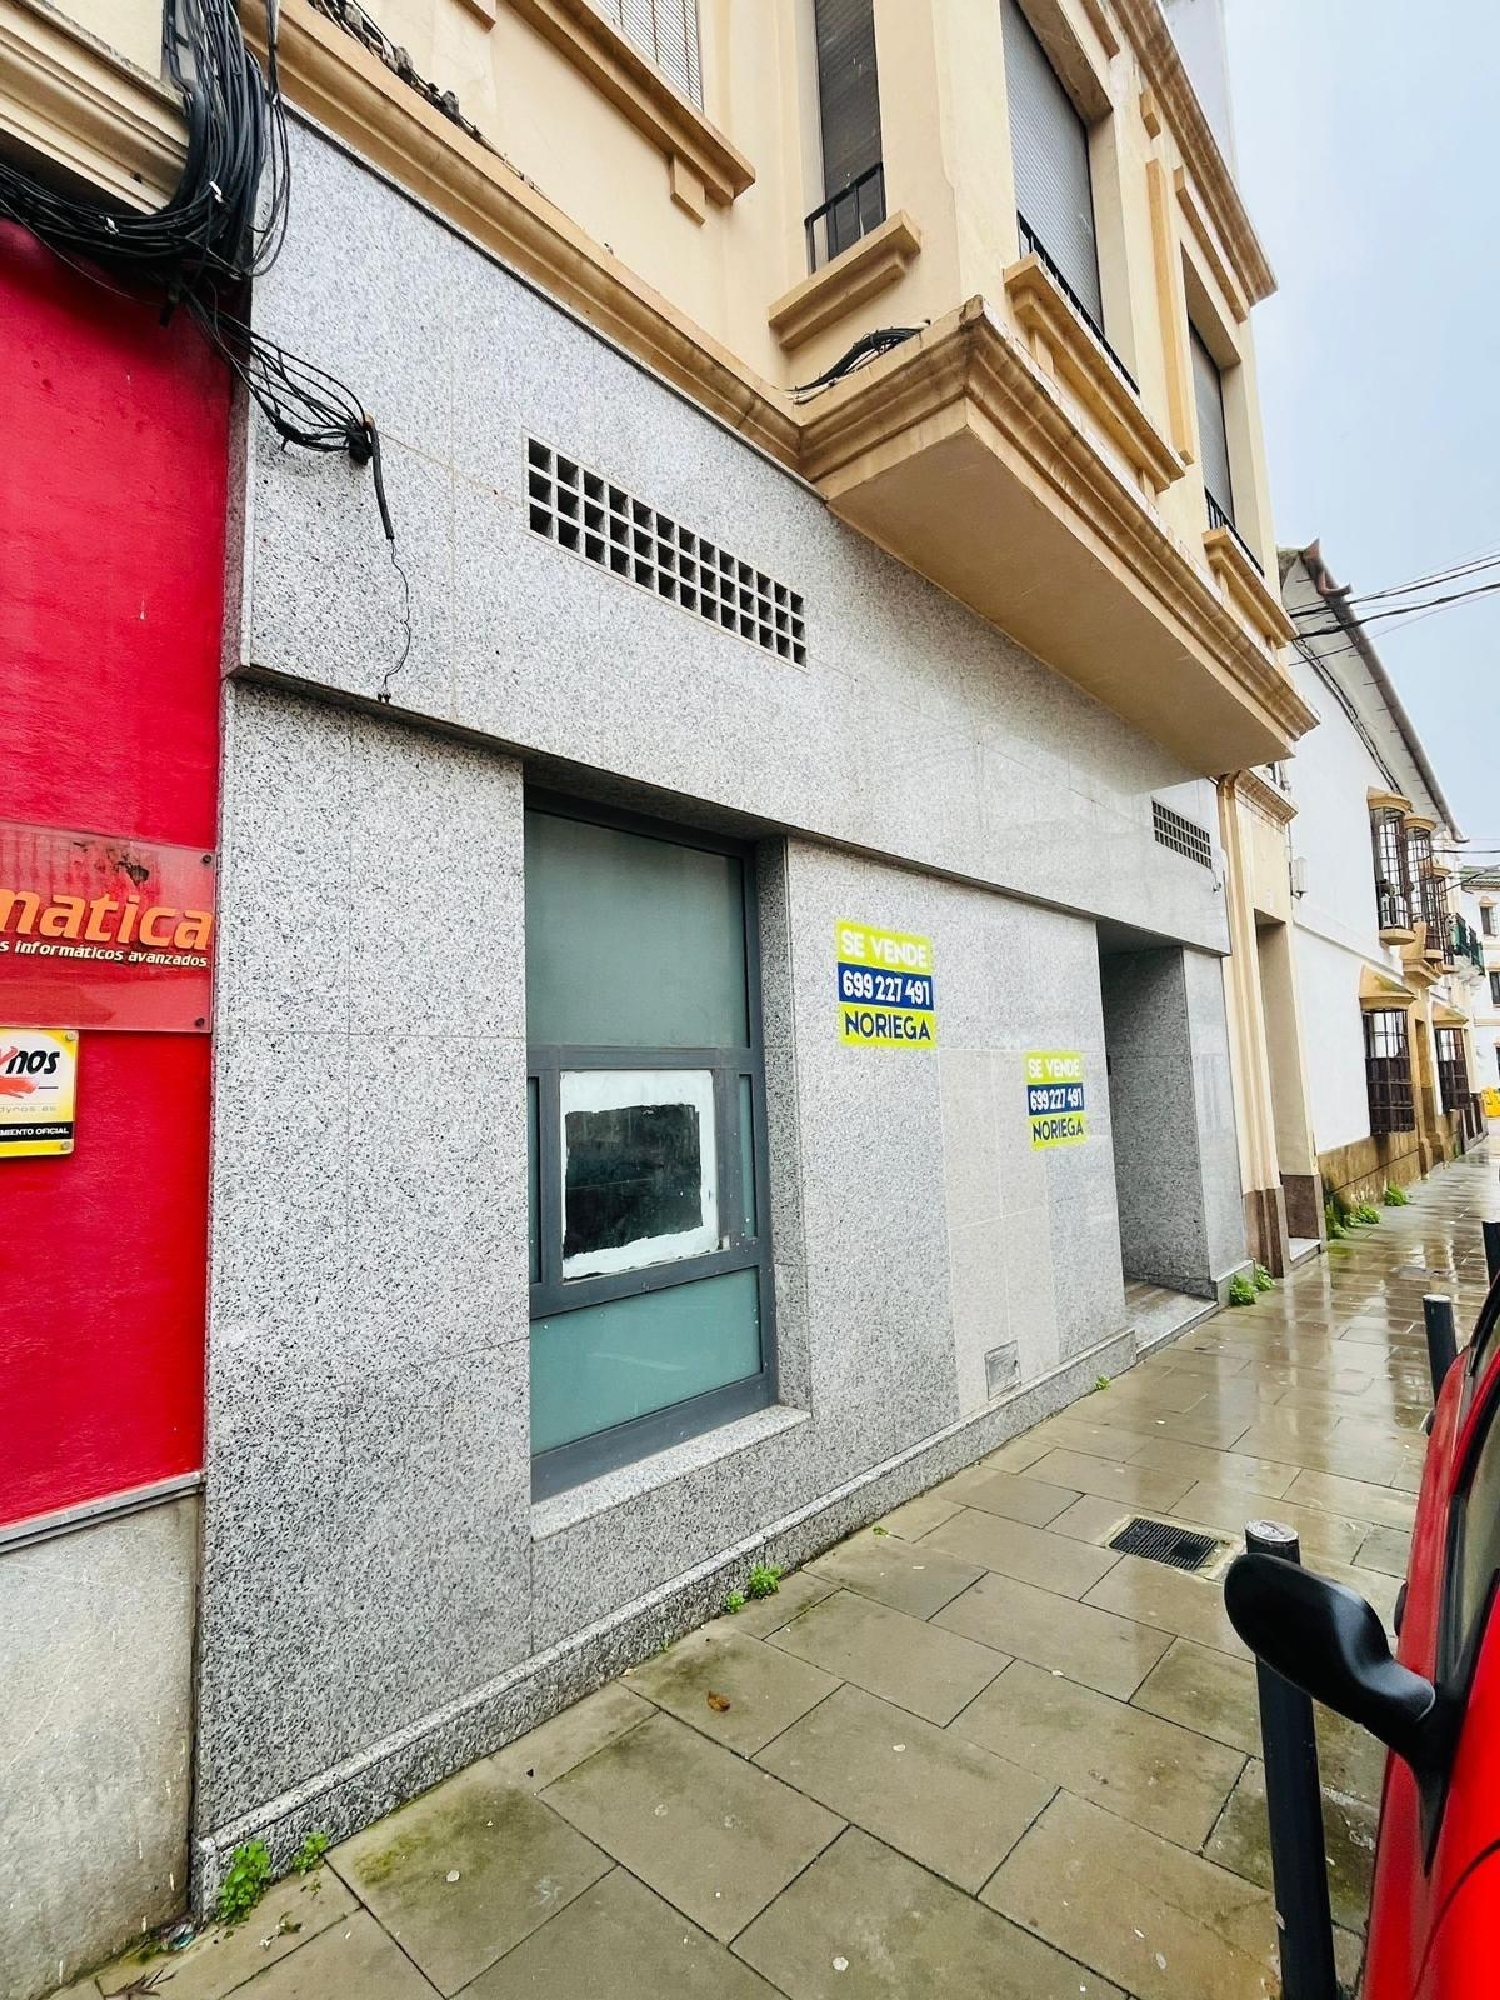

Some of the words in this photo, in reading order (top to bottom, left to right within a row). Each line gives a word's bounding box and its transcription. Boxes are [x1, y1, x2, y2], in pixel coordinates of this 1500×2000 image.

[15, 940, 123, 960] informáticos
[128, 950, 207, 967] avanzados
[841, 930, 865, 959] SE
[870, 937, 928, 967] VENDE
[843, 970, 874, 1000] 699
[875, 976, 902, 1002] 227
[905, 980, 930, 1005] 491
[844, 1010, 931, 1041] NORIEGA
[1028, 1059, 1044, 1078] SE
[1046, 1058, 1081, 1077] VENDE
[1030, 1090, 1049, 1110] 699
[1050, 1089, 1066, 1109] 227
[1067, 1087, 1082, 1107] 491
[35, 1127, 70, 1136] OFICIAL
[1033, 1117, 1084, 1142] NORIEGA
